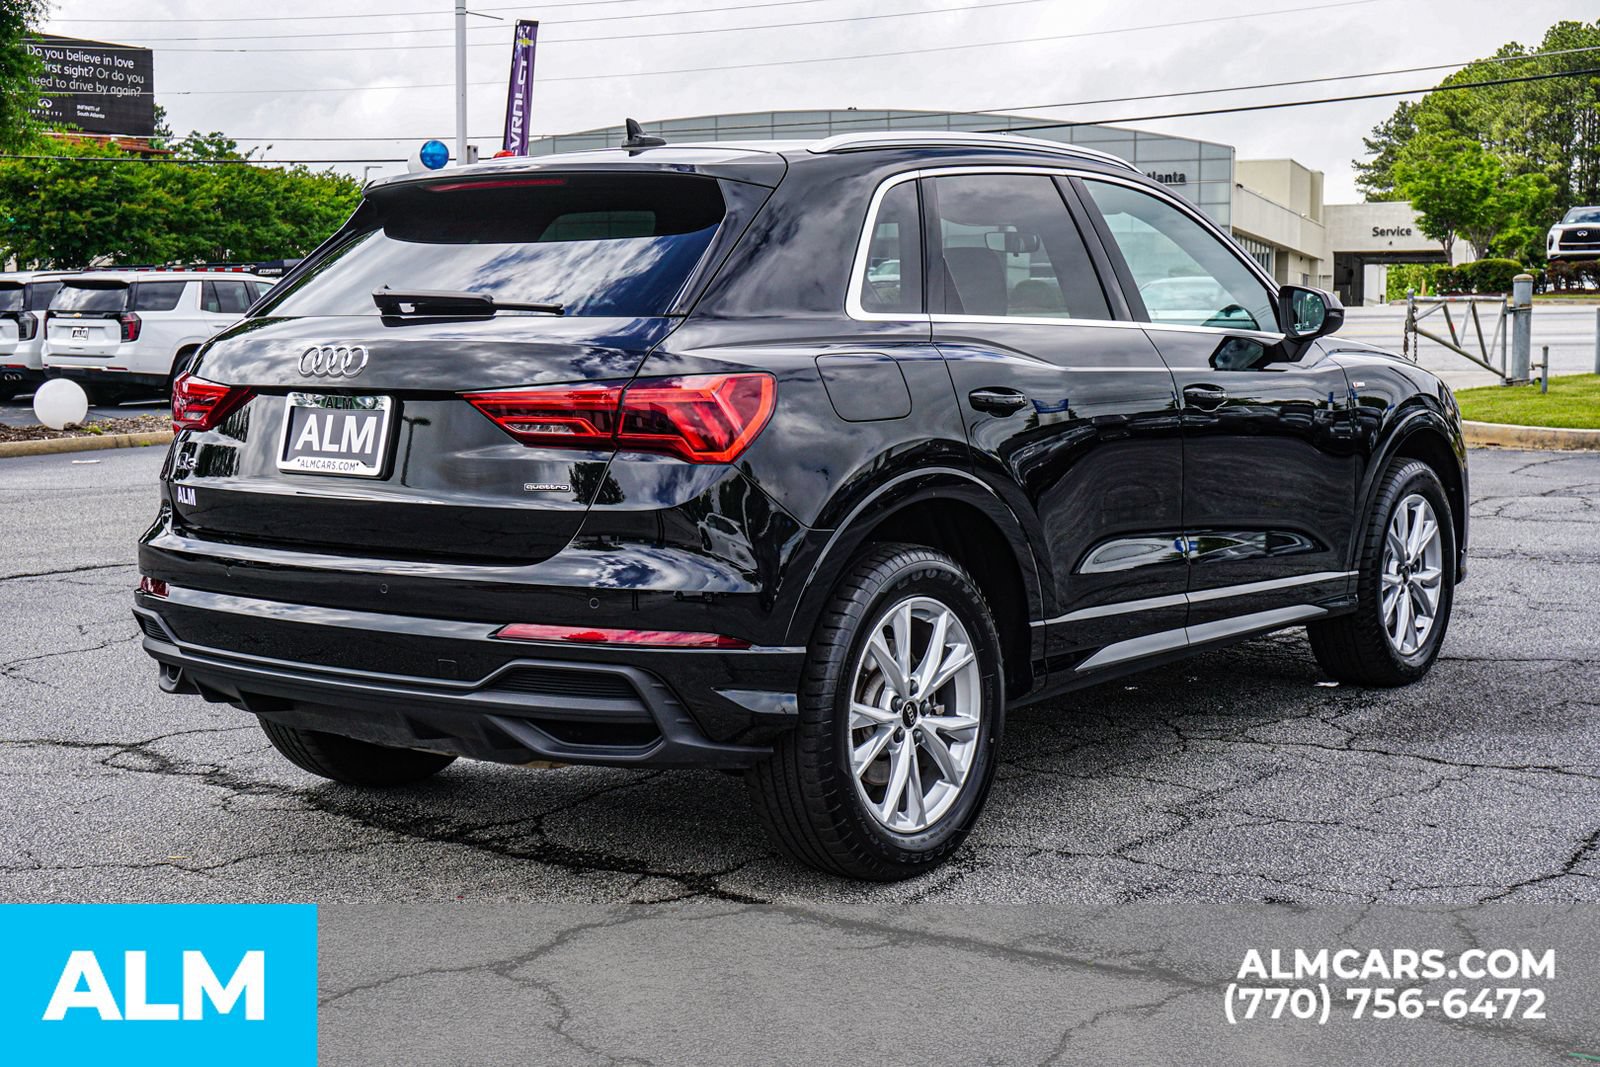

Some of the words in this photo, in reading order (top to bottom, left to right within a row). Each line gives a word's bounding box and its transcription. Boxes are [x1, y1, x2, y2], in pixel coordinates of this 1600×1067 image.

[26, 44, 43, 57] Do
[45, 49, 64, 60] you
[66, 49, 101, 65] believe
[103, 53, 112, 66] in
[114, 55, 134, 69] love
[64, 64, 94, 78] sight?
[96, 67, 110, 79] Or
[111, 70, 125, 81] do
[126, 74, 144, 85] you
[56, 78, 67, 89] to
[69, 79, 94, 92] drive
[96, 81, 108, 95] by
[110, 85, 142, 98] again?
[1372, 226, 1412, 237] Service
[294, 413, 377, 454] ALM
[177, 486, 197, 506] ALM
